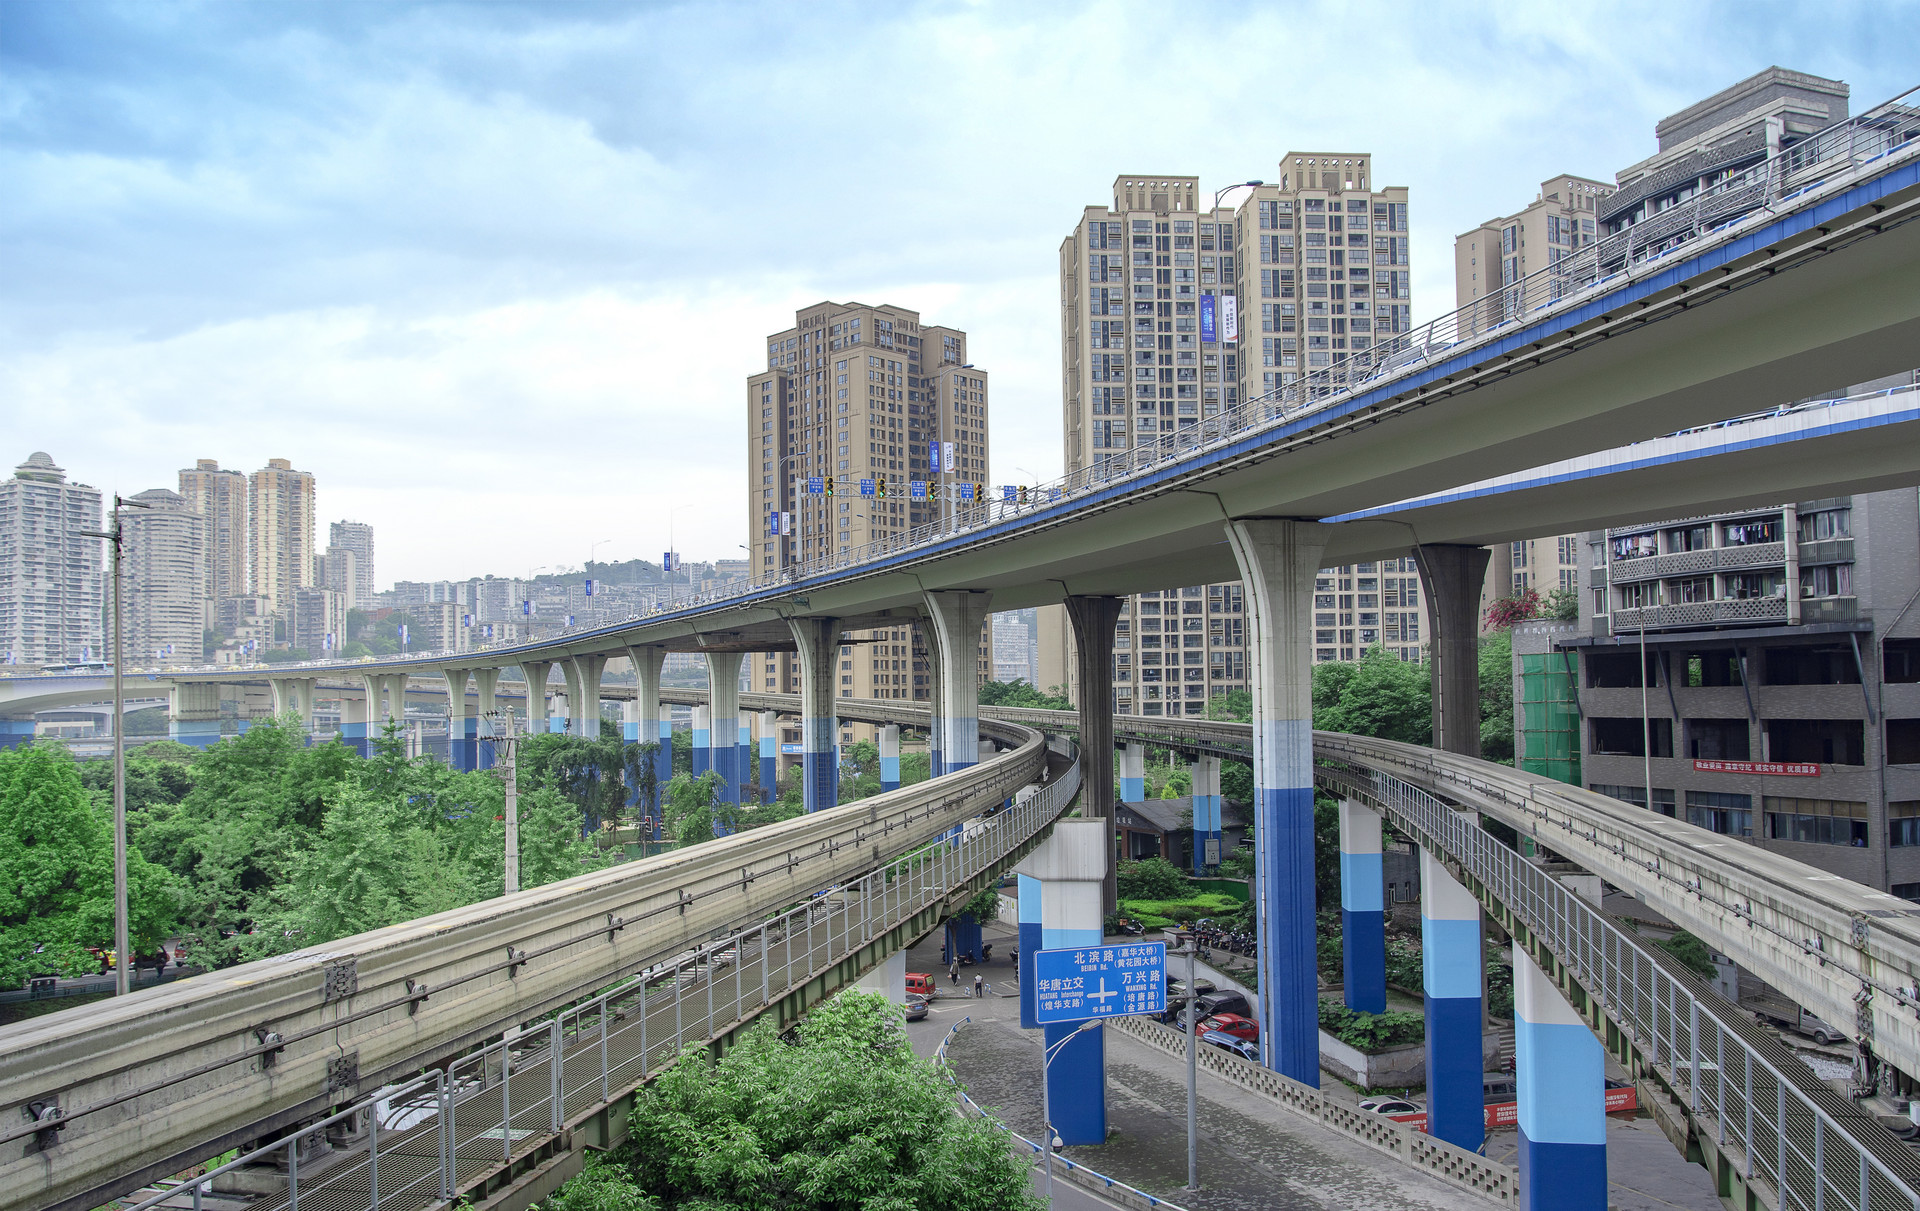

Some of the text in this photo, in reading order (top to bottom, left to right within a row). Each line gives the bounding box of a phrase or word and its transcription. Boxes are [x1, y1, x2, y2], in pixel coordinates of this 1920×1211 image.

[1074, 949, 1114, 965] 北滨路
[1038, 976, 1084, 992] 华唐立交
[1121, 969, 1160, 985] 万兴路
[1125, 983, 1147, 992] WANXING
